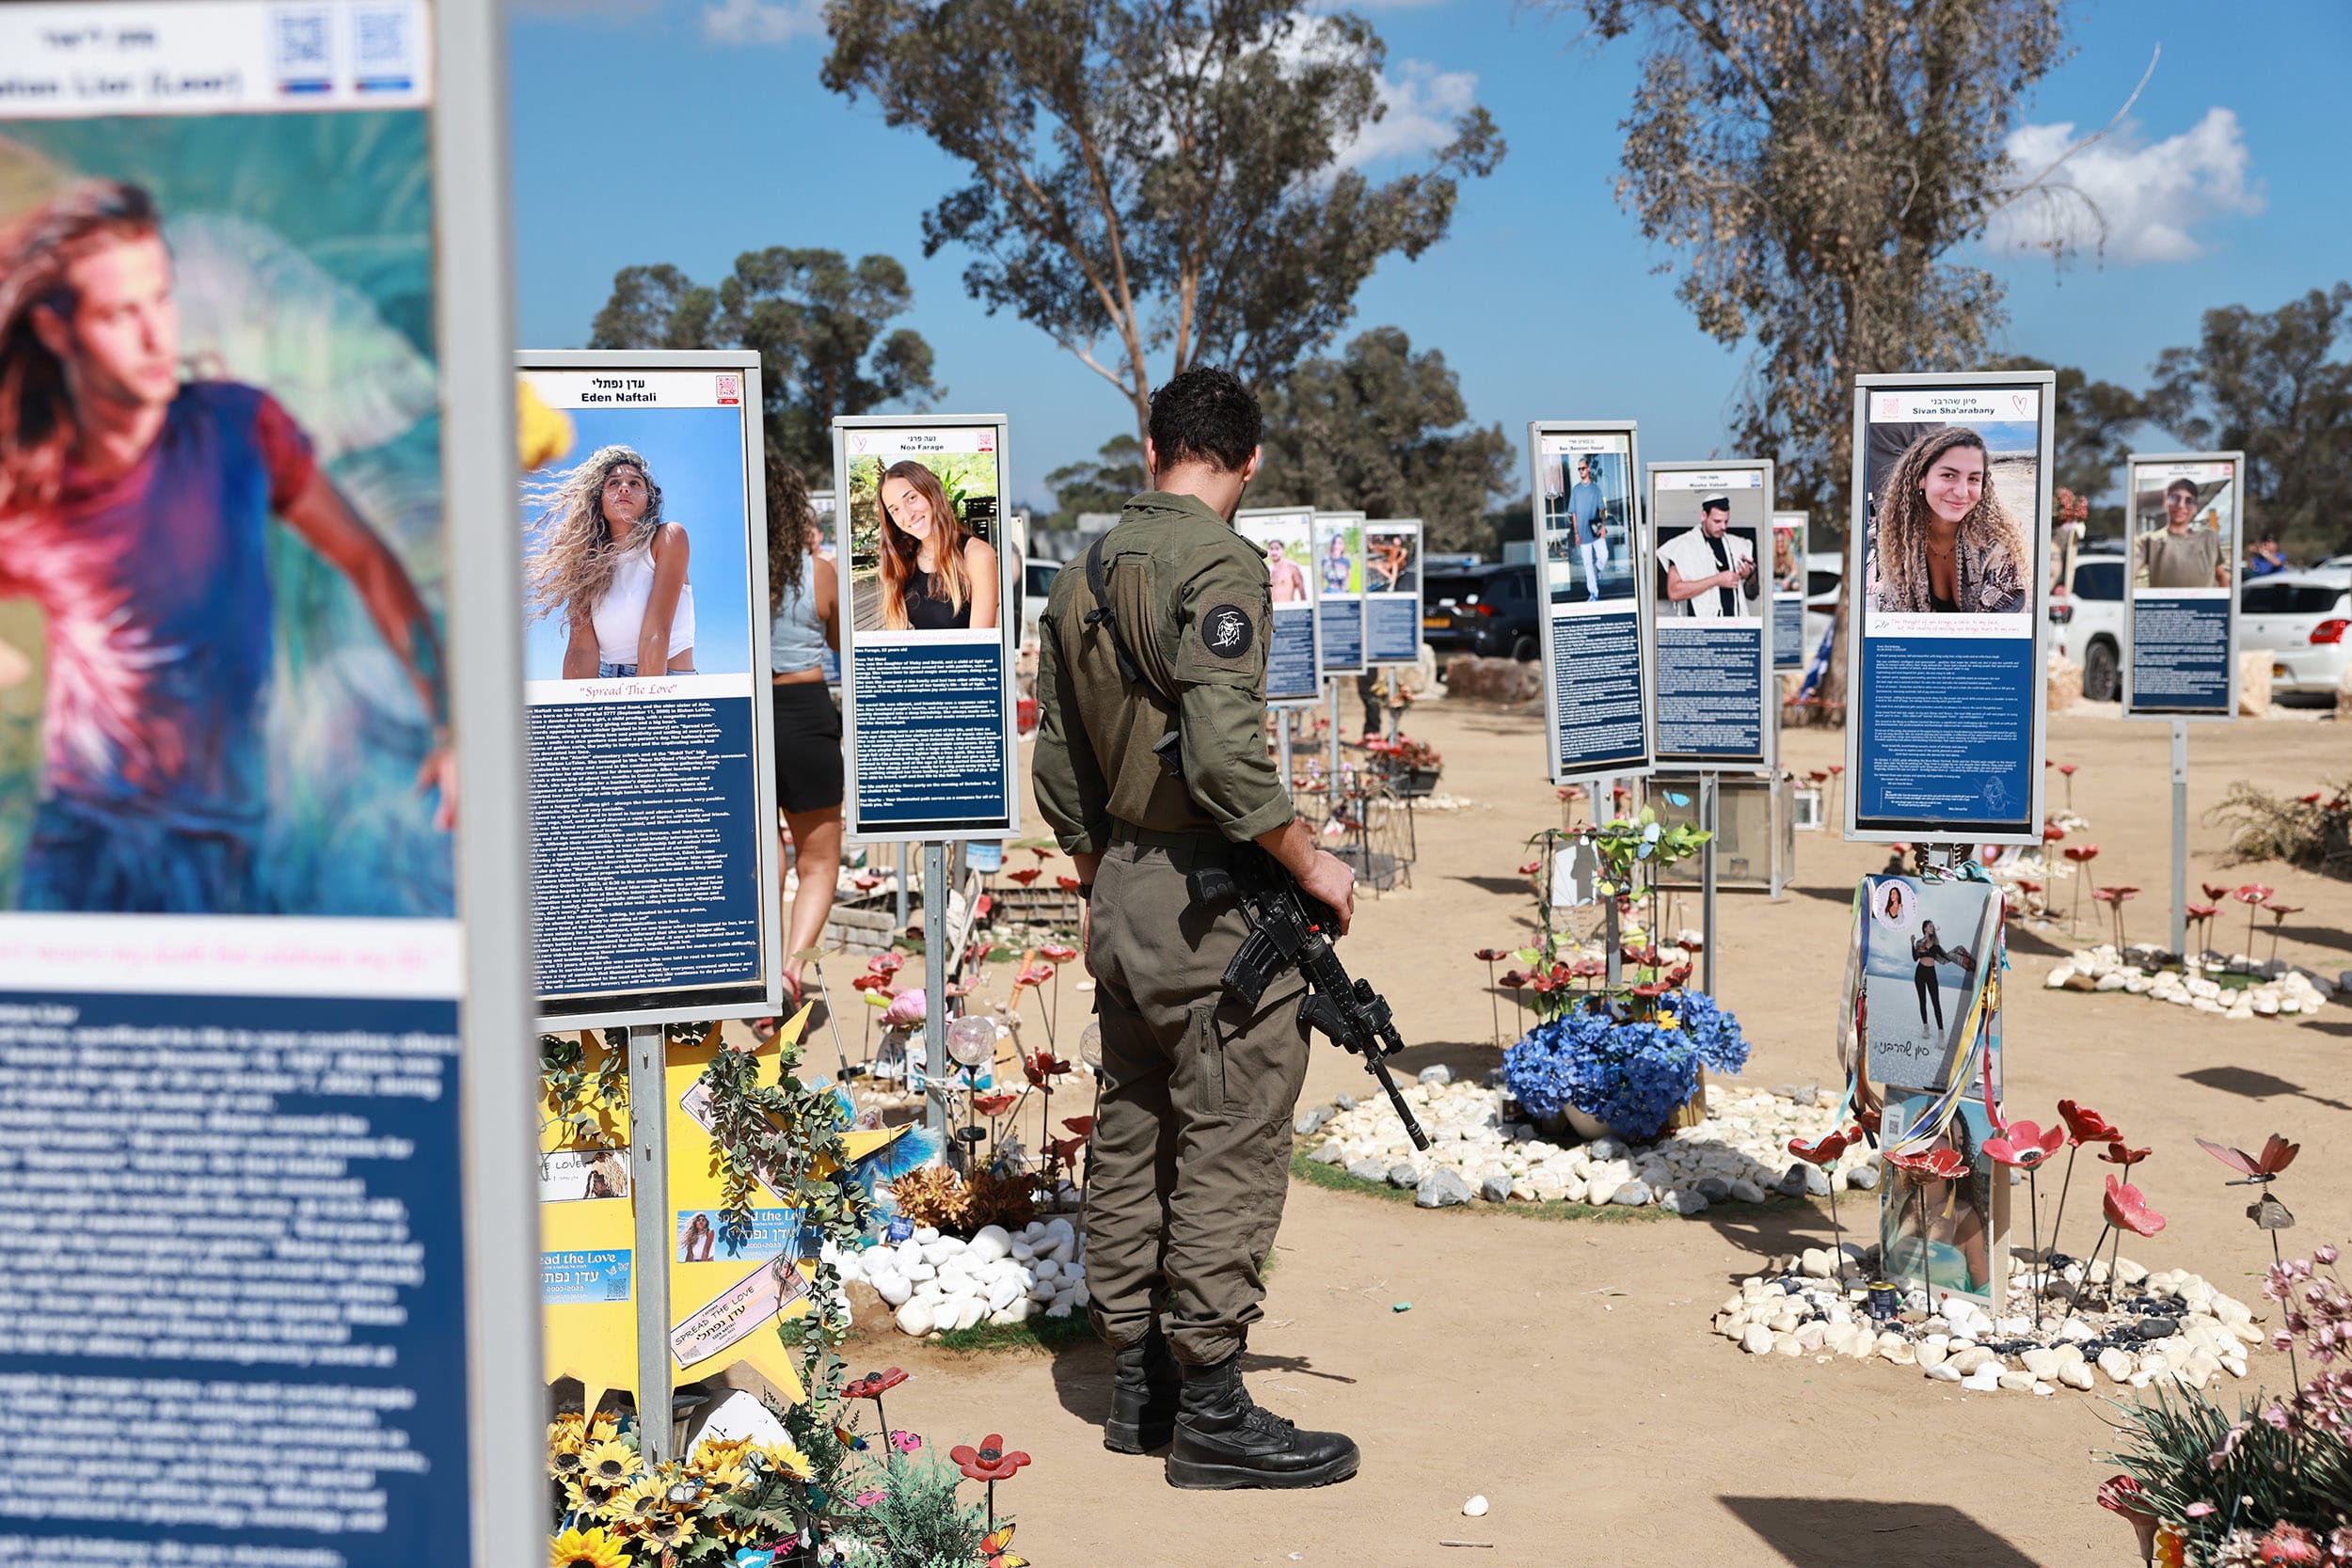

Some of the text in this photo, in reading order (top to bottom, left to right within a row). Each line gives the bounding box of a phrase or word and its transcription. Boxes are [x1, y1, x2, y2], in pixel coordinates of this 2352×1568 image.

[591, 378, 645, 390] עדן נפתלי
[581, 392, 657, 403] Eden Naftali
[580, 683, 678, 696] "Spread The Love"
[1879, 1040, 1930, 1061] סיון שהרבני
[556, 1161, 581, 1169] LOVE
[762, 1211, 782, 1221] the
[564, 1253, 584, 1264] the
[588, 1252, 617, 1263] Love
[576, 1271, 599, 1284] עדן
[675, 1319, 709, 1346] SPREAD
[711, 1304, 729, 1319] THE
[732, 1286, 755, 1305] LOVE
[696, 1305, 746, 1341] עדן נפתלי
